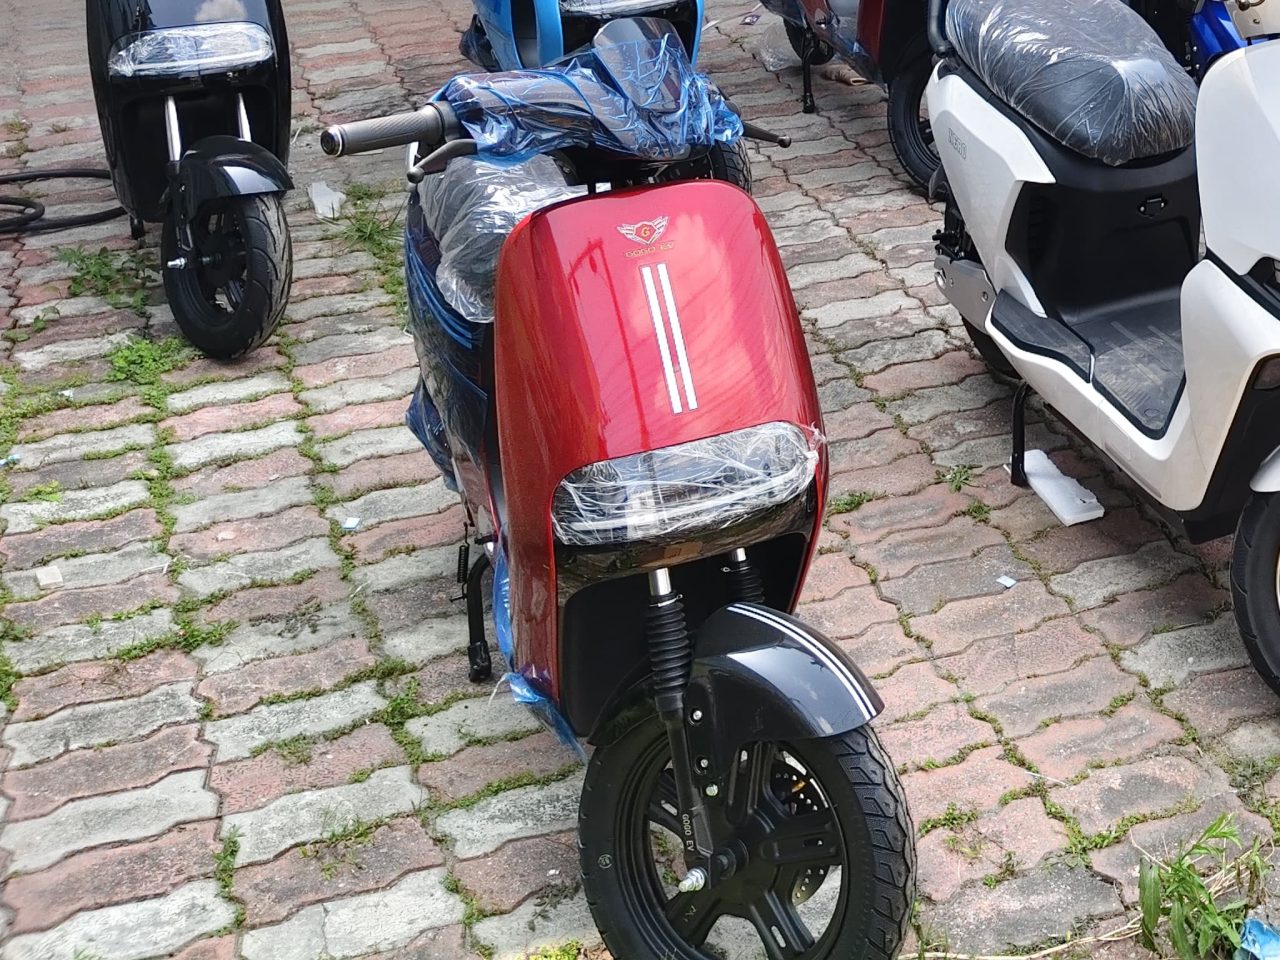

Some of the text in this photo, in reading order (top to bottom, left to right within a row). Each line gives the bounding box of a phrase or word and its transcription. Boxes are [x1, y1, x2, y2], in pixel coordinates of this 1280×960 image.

[641, 226, 651, 237] G
[681, 813, 695, 851] GOGO EV
